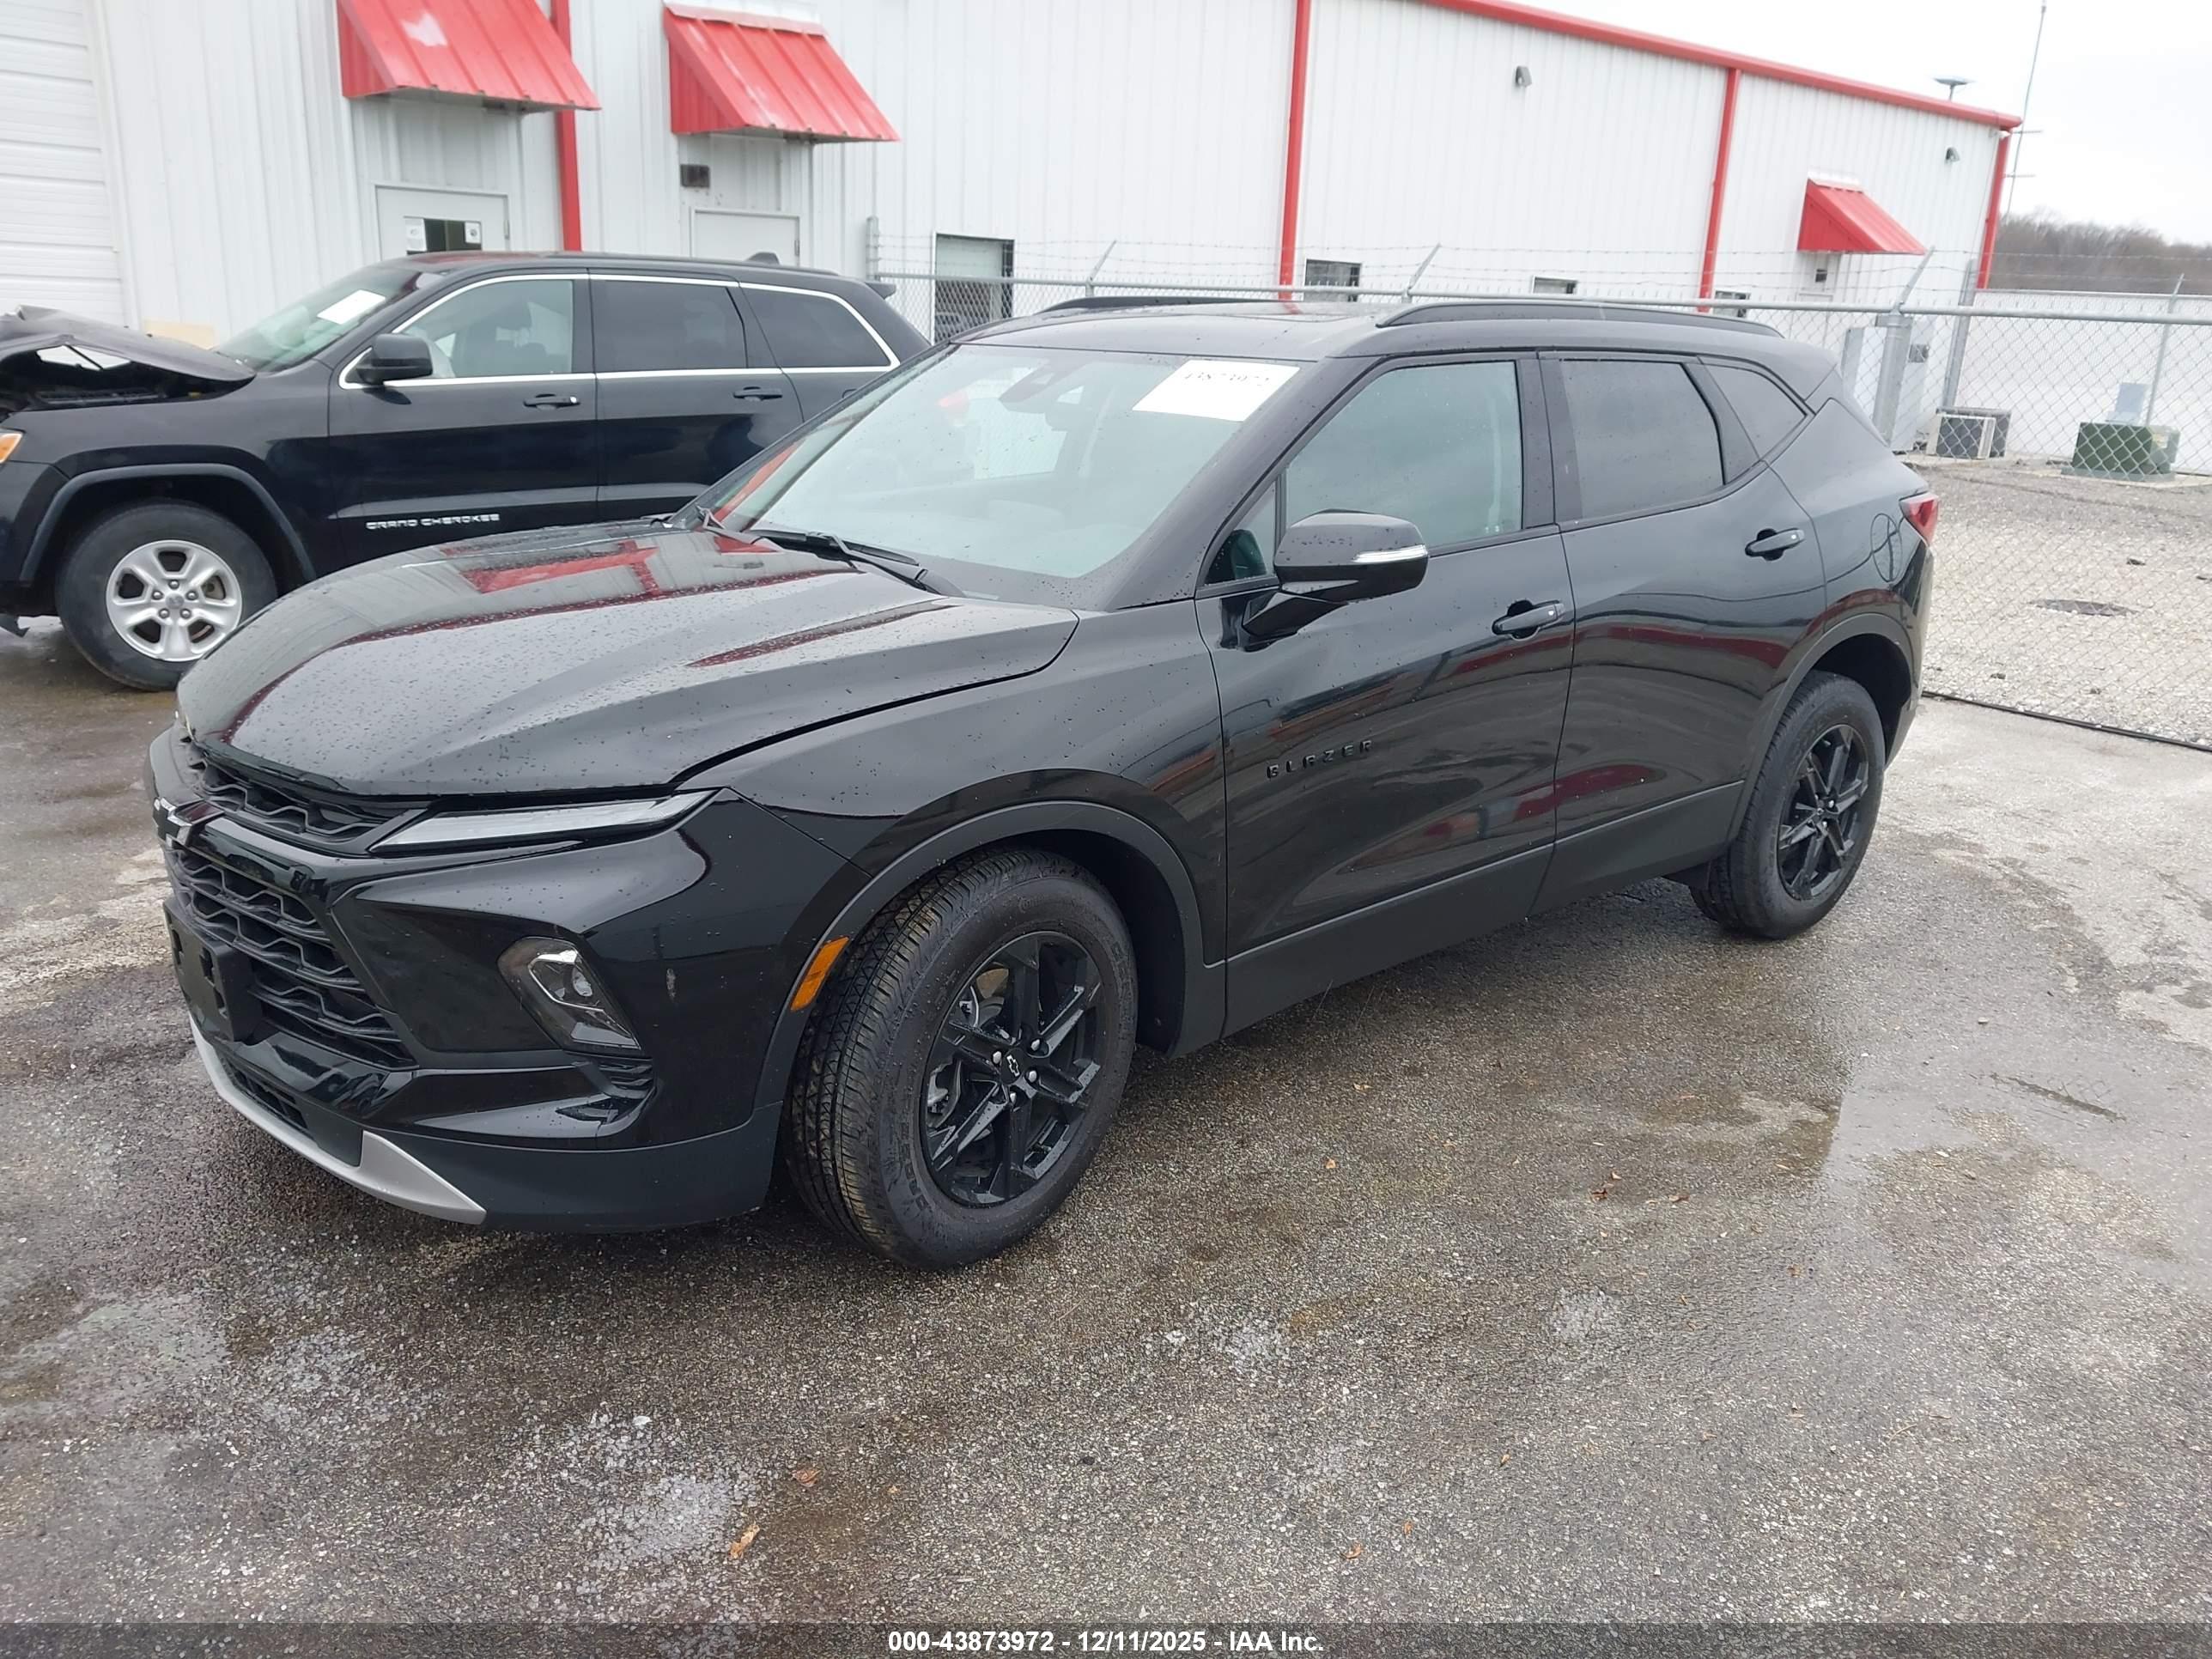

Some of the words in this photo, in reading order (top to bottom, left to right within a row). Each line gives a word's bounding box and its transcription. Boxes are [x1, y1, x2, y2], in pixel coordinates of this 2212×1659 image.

[366, 520, 418, 530] GRAND
[421, 514, 501, 526] CHEROKEE
[1267, 739, 1373, 779] BLAZER
